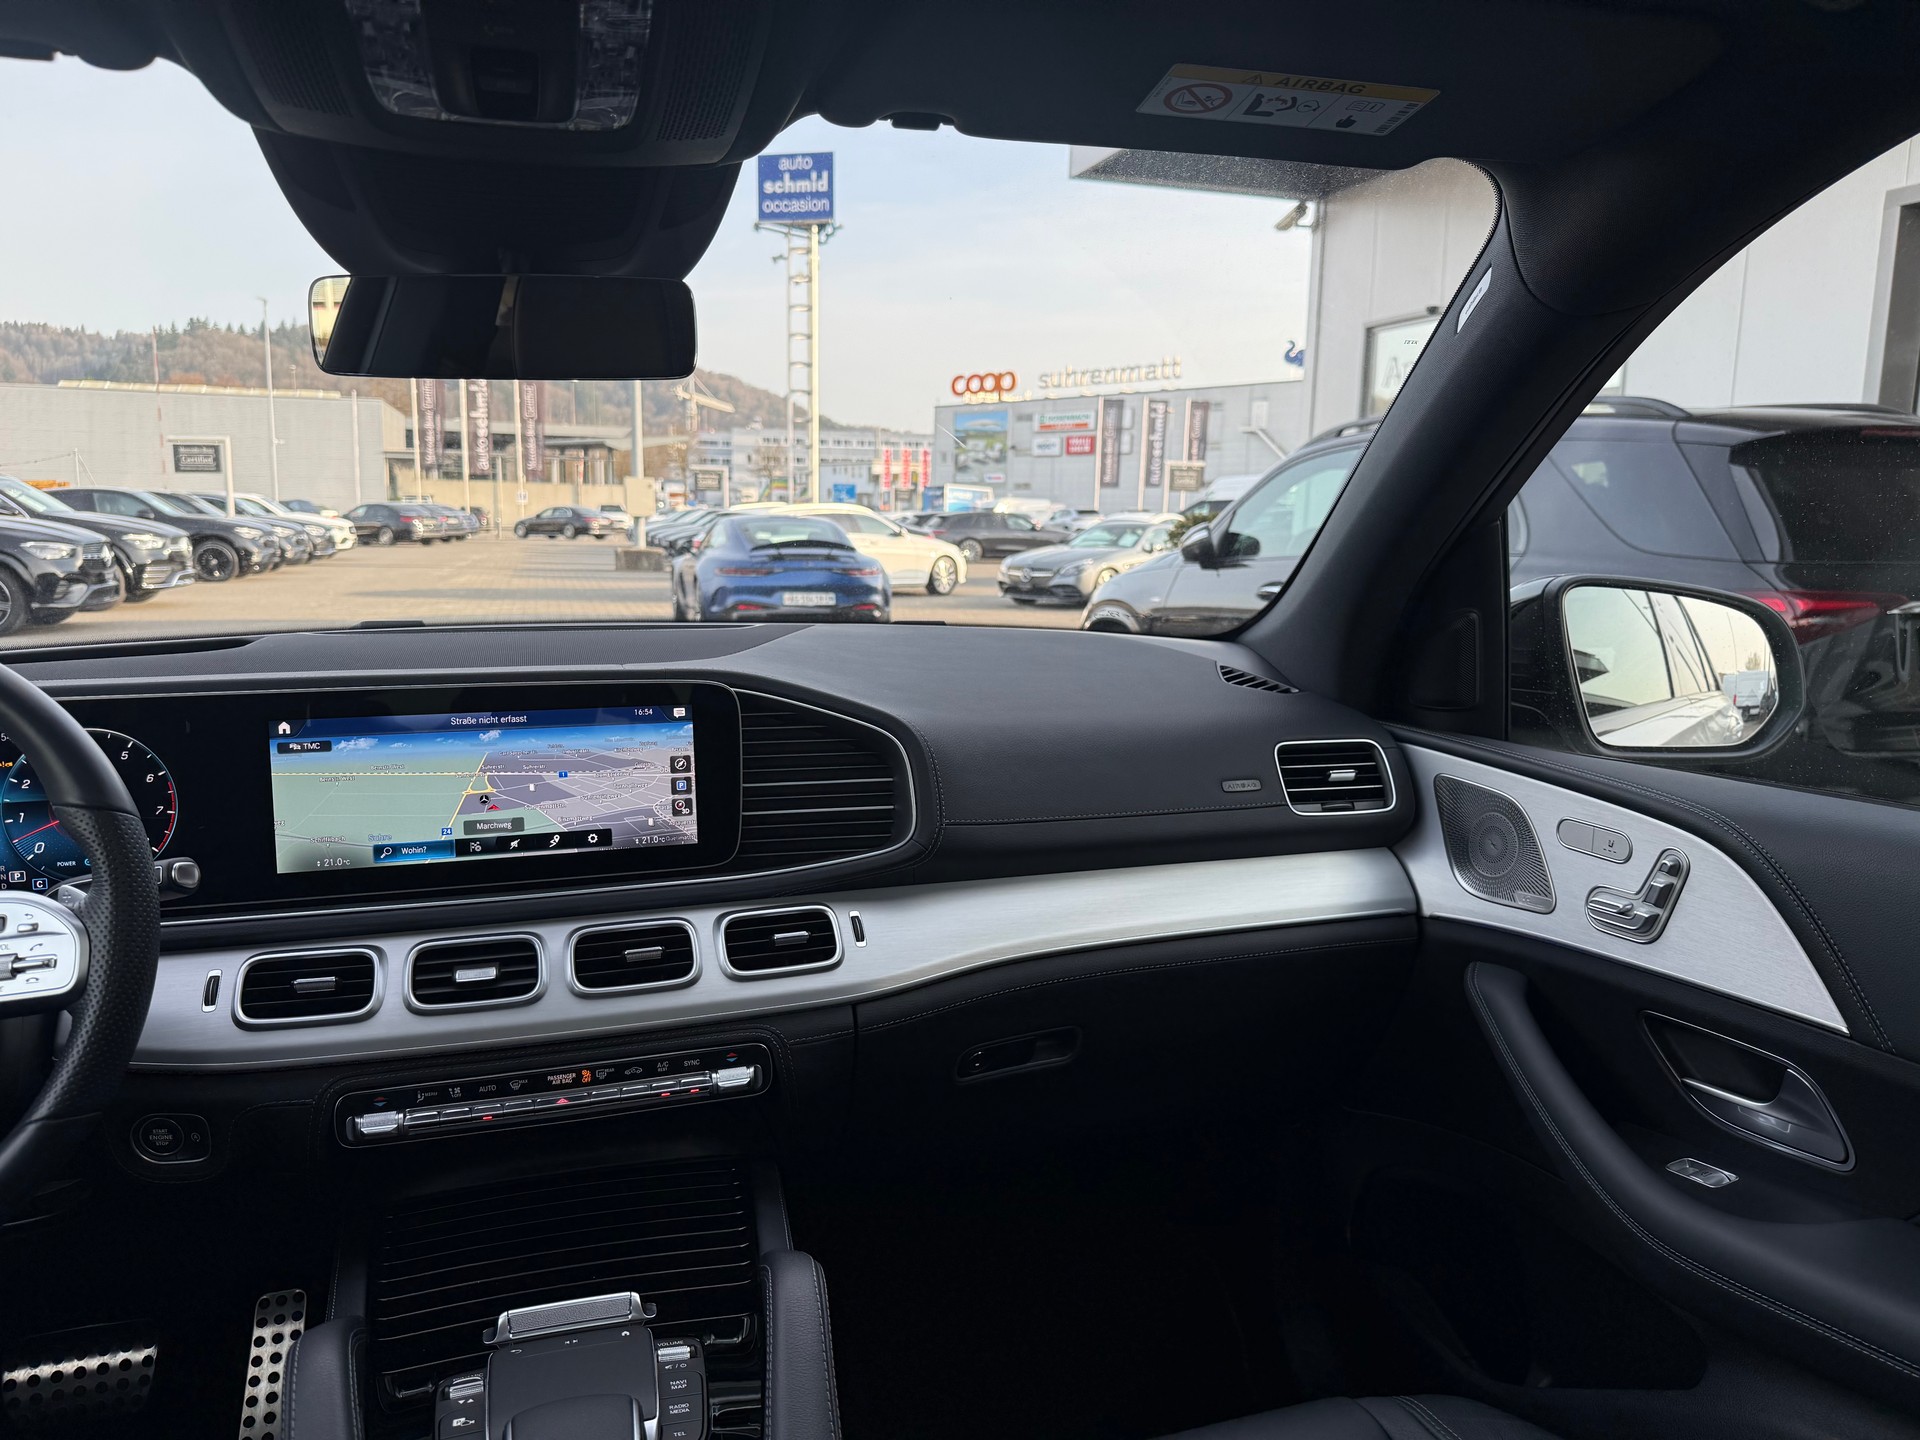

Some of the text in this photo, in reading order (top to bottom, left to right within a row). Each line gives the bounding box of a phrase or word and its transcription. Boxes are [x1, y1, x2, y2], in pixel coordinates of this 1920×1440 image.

[1274, 76, 1367, 95] AIRBAG
[778, 155, 813, 171] auto
[763, 170, 829, 194] schmid
[762, 195, 830, 213] occasion
[1038, 355, 1182, 389] suhrenmatt
[952, 371, 1017, 401] coop
[1148, 402, 1166, 485] autoschmid
[634, 708, 653, 716] 16:54
[450, 714, 528, 726] Straße nicht erfasst
[302, 742, 321, 750] TMC
[120, 751, 129, 760] 5
[146, 773, 155, 783] 6
[21, 779, 31, 789] 2
[155, 805, 164, 815] 7
[19, 812, 25, 823] 1
[476, 821, 513, 831] Marchweg
[34, 842, 45, 853] 0
[401, 845, 427, 854] Wohin?
[14, 873, 21, 881] P
[683, 1059, 700, 1067] SYNC
[547, 1072, 577, 1081] PASSENGER
[479, 1084, 497, 1092] AUTO
[669, 1402, 690, 1410] RADIO
